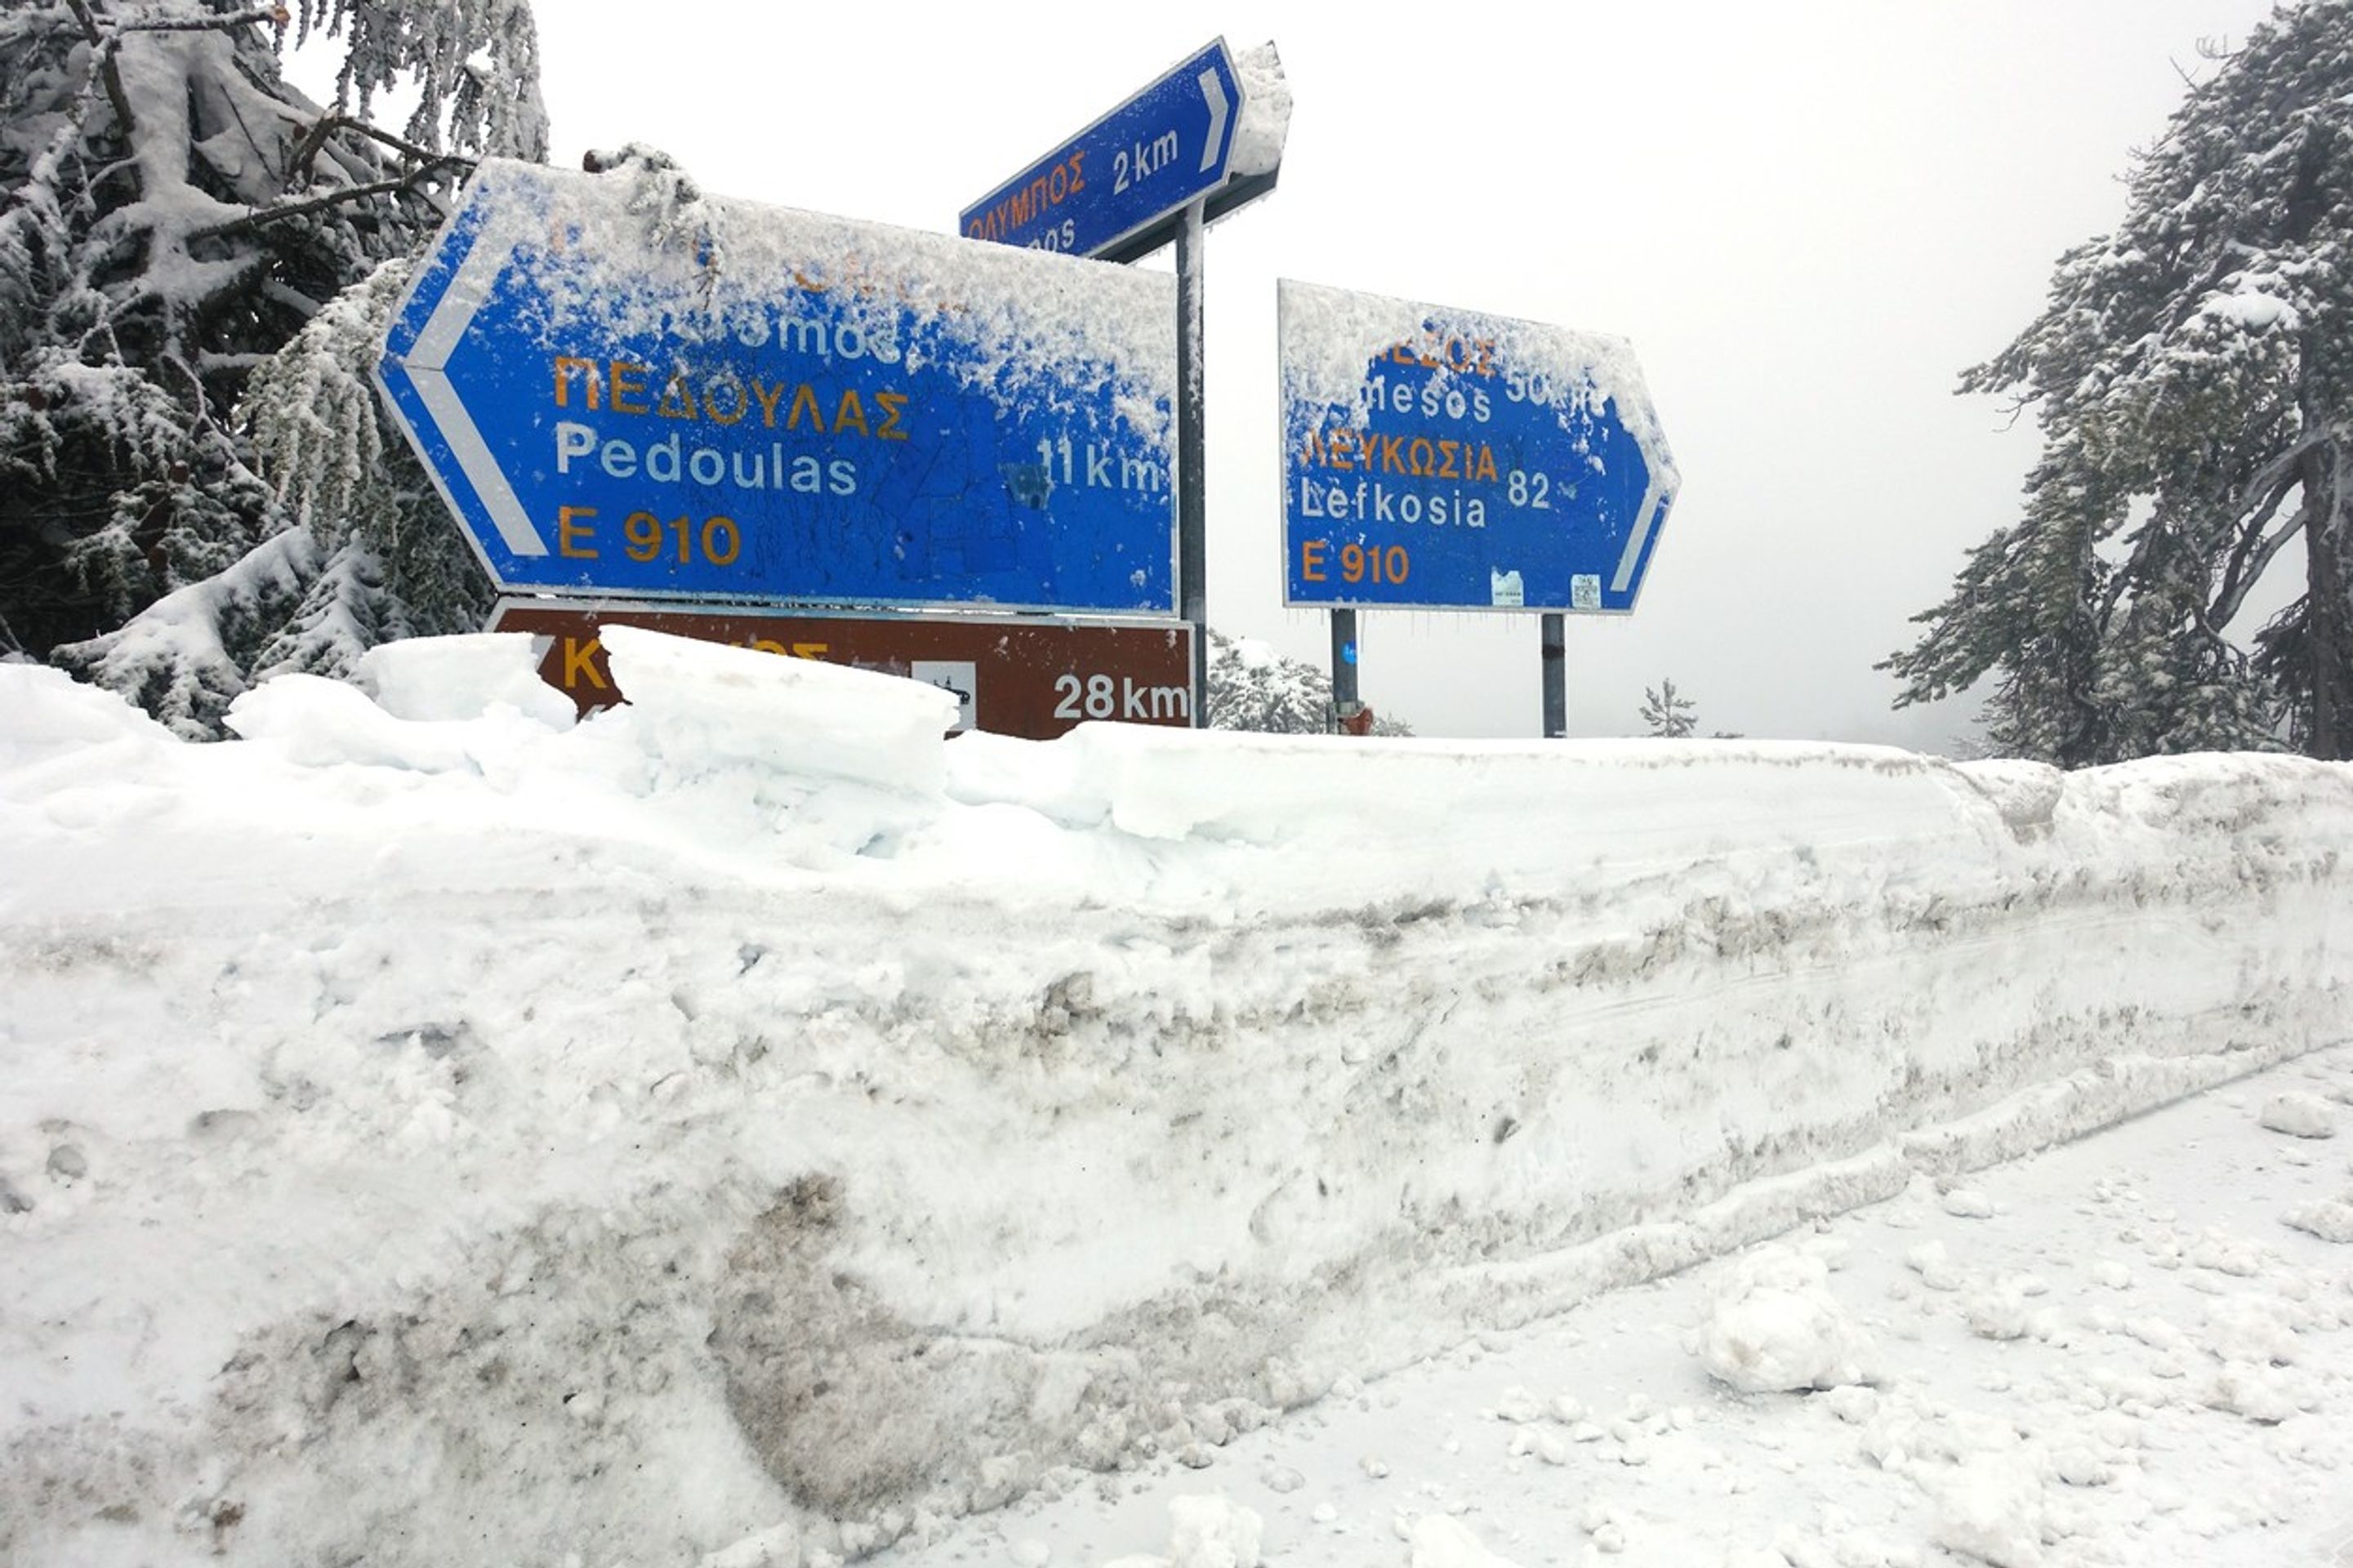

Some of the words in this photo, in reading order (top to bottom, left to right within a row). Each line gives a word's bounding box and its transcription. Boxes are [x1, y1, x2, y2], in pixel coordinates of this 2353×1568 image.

[555, 356, 909, 441] ΠΕΔΟΥΛΑΣ
[556, 421, 857, 496] Pedoulas
[1301, 476, 1486, 528] Lefkosia
[1508, 470, 1549, 509] 82
